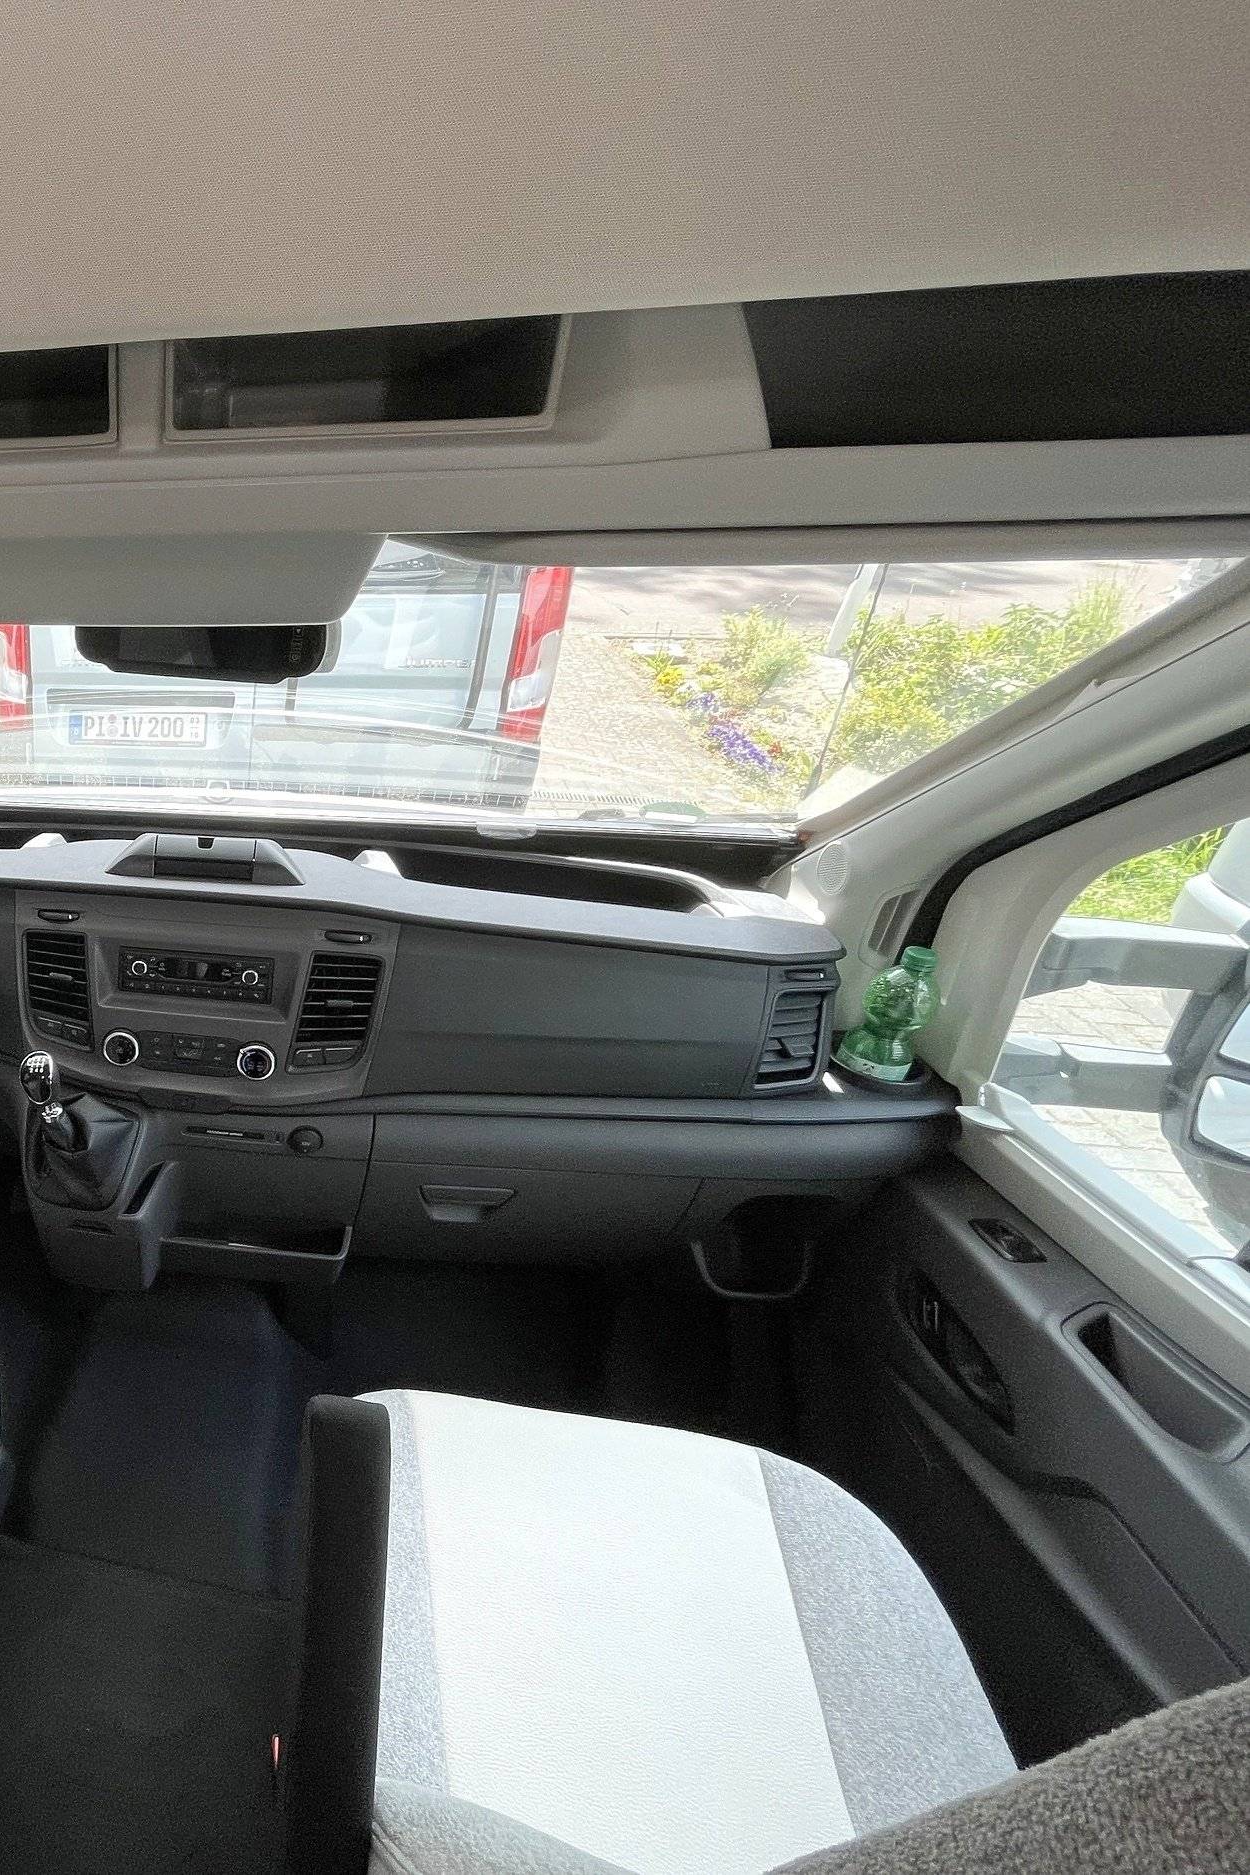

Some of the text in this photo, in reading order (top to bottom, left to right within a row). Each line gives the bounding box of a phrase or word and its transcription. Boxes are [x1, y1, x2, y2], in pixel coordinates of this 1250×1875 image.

[84, 716, 105, 737] PI
[120, 717, 144, 738] IV
[149, 717, 184, 738] 200
